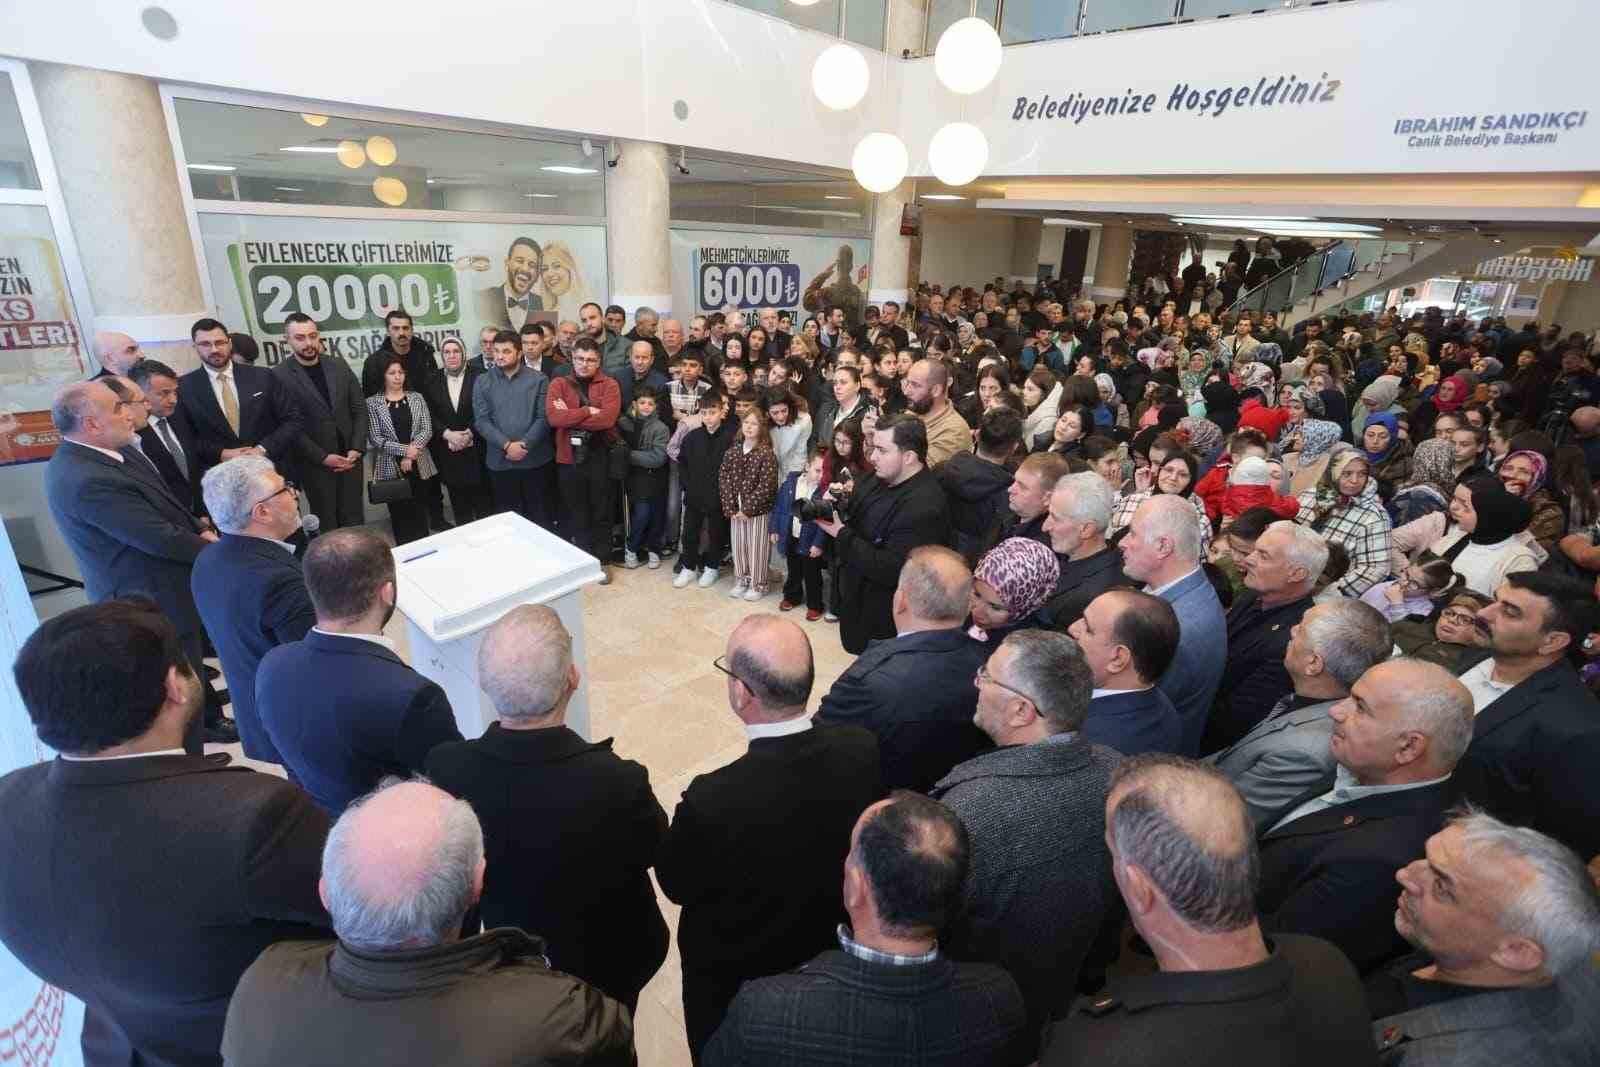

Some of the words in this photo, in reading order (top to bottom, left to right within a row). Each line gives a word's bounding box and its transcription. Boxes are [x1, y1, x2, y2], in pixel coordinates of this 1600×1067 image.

[1012, 89, 1156, 124] Belediyenize
[1166, 71, 1341, 118] Hoşgeldiniz
[1480, 110, 1588, 131] SANDIKÇI
[1408, 135, 1441, 147] Canik
[1445, 133, 1500, 149] Belediye
[244, 242, 346, 264] EVLENECEK
[351, 240, 454, 266] ÇİFTLERİMİZE
